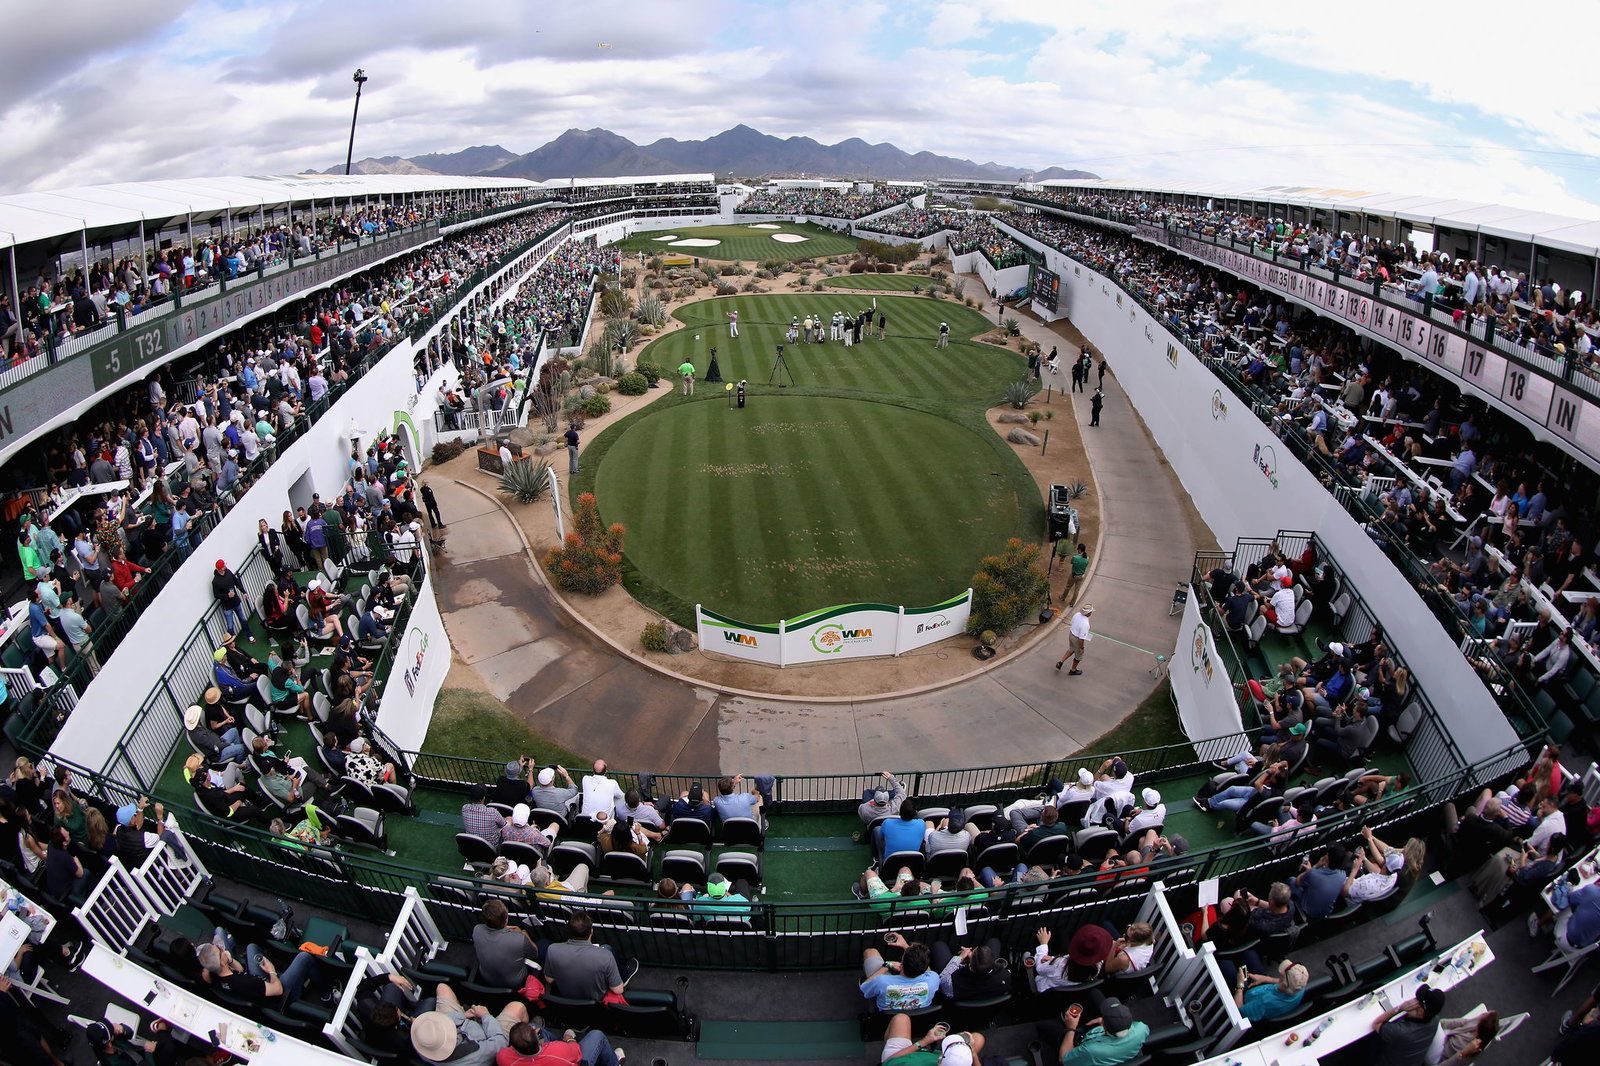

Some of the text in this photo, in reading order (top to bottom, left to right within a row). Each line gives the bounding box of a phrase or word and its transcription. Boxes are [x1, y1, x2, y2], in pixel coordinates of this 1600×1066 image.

[105, 349, 121, 374] -5
[136, 328, 163, 360] T32
[174, 322, 179, 342] 1
[187, 318, 193, 336] 3
[200, 310, 206, 329] 2
[212, 306, 218, 322] 4
[226, 301, 231, 318] 3
[248, 292, 253, 308] 4
[258, 289, 263, 304] 3
[268, 285, 273, 300] 5
[276, 282, 280, 296] 4
[1269, 268, 1278, 283] OUT
[1279, 272, 1288, 287] 35
[1290, 275, 1297, 290] 10
[1299, 280, 1303, 292] 4
[1308, 281, 1315, 298] 11
[1318, 286, 1322, 301] 4
[1328, 289, 1336, 306] 12
[1339, 294, 1344, 310] 3
[1350, 297, 1358, 316] 13
[1360, 303, 1366, 320] 4
[1374, 306, 1384, 328] 14
[1388, 313, 1394, 334] 4
[1402, 318, 1412, 341] 15
[1418, 326, 1424, 346] 5
[1434, 333, 1445, 358] 16
[1469, 350, 1484, 377] 17
[1510, 371, 1525, 401] 18
[1556, 398, 1576, 432] IN
[842, 629, 872, 638] WM
[925, 620, 951, 631] FedExCup
[723, 630, 758, 646] WM
